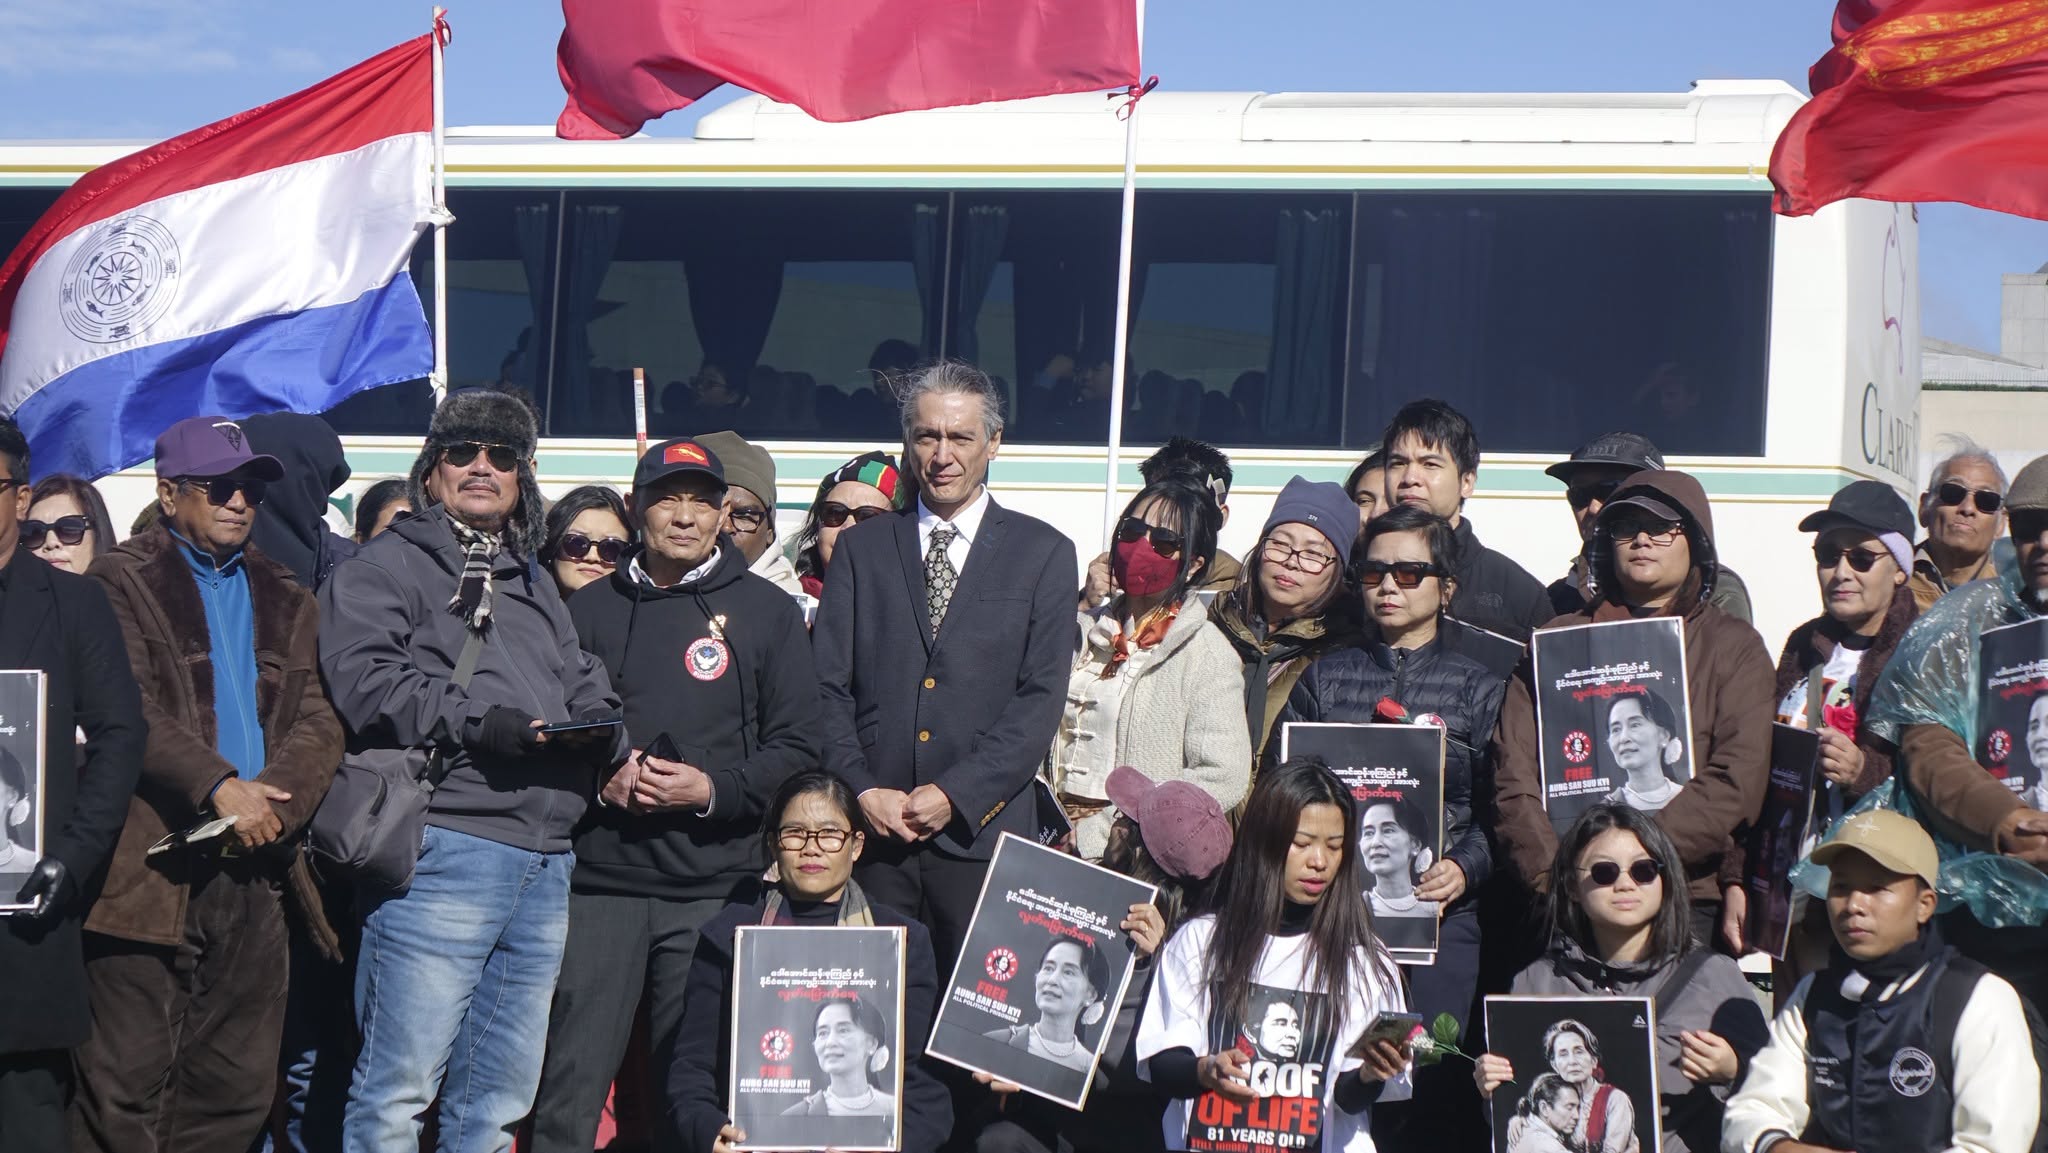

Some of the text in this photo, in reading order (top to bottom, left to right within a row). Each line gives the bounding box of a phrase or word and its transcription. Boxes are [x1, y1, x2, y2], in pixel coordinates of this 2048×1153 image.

[1548, 777, 1610, 793] AUNG SAN SUU KYI
[992, 948, 1017, 963] PROOF
[954, 986, 1022, 1018] AUNG SAN SUU KYI
[976, 980, 1009, 1003] FREE
[962, 998, 989, 1014] POLITICAL
[989, 1008, 1019, 1024] PRISONERS
[740, 1078, 811, 1089] AUNG SAN SUU KYI
[1198, 1093, 1319, 1135] OF LIFE
[1207, 1127, 1305, 1149] 81 YEARS OLD
